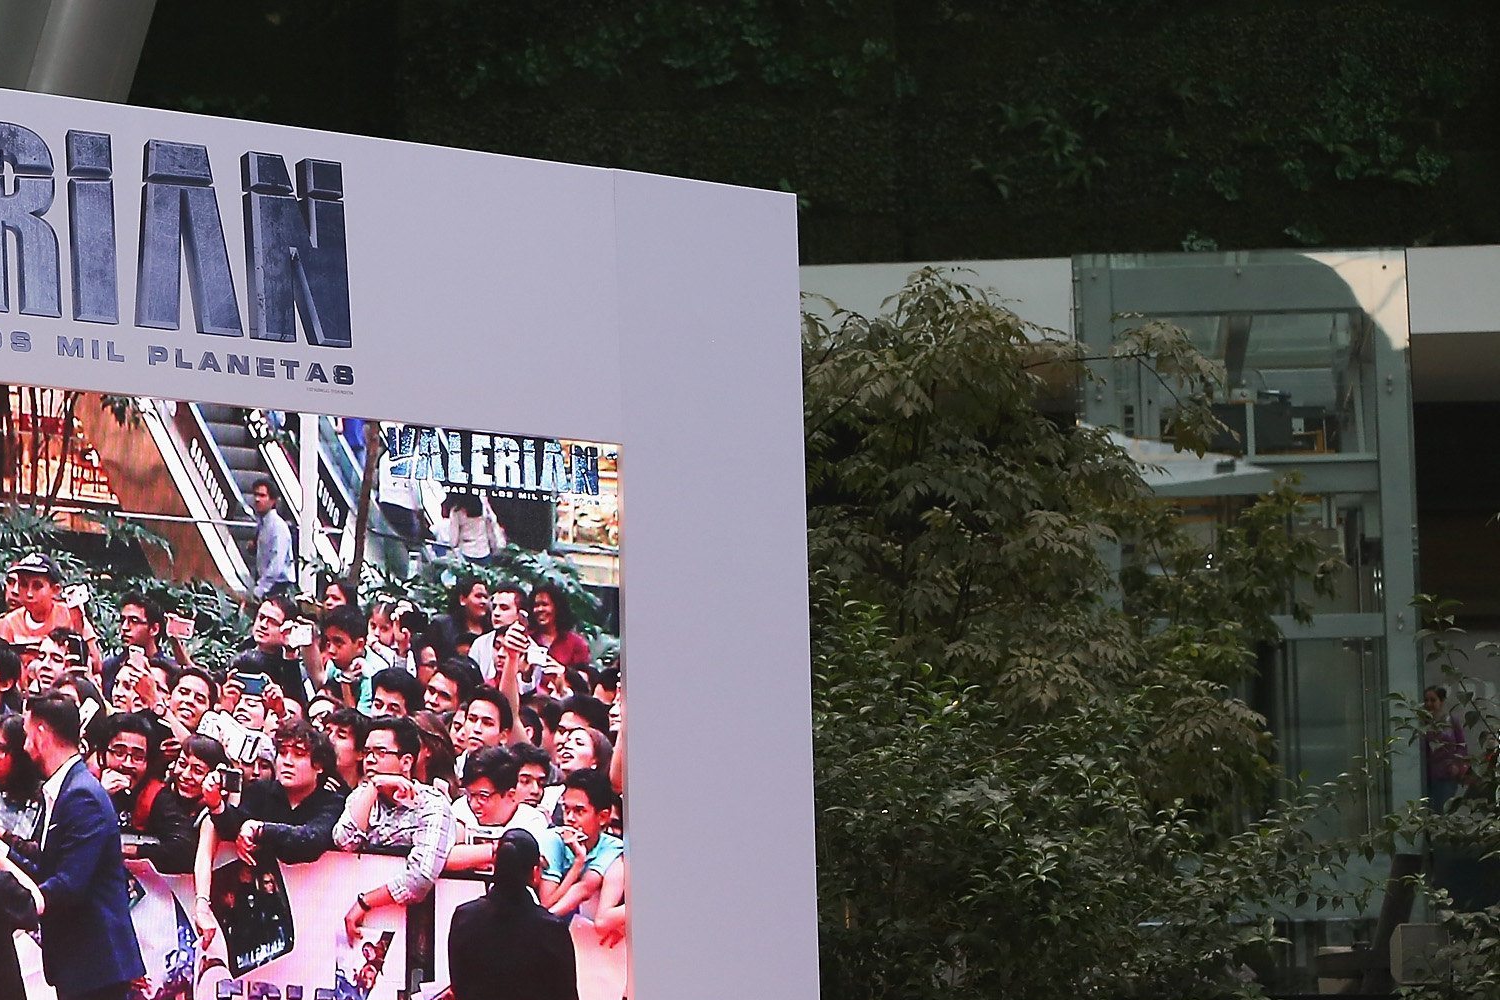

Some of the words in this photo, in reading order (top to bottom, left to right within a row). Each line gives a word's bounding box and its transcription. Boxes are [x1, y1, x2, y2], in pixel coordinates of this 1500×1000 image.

[57, 335, 126, 363] MIL
[147, 345, 355, 386] PLANETAS
[387, 426, 600, 496] VALERIAN
